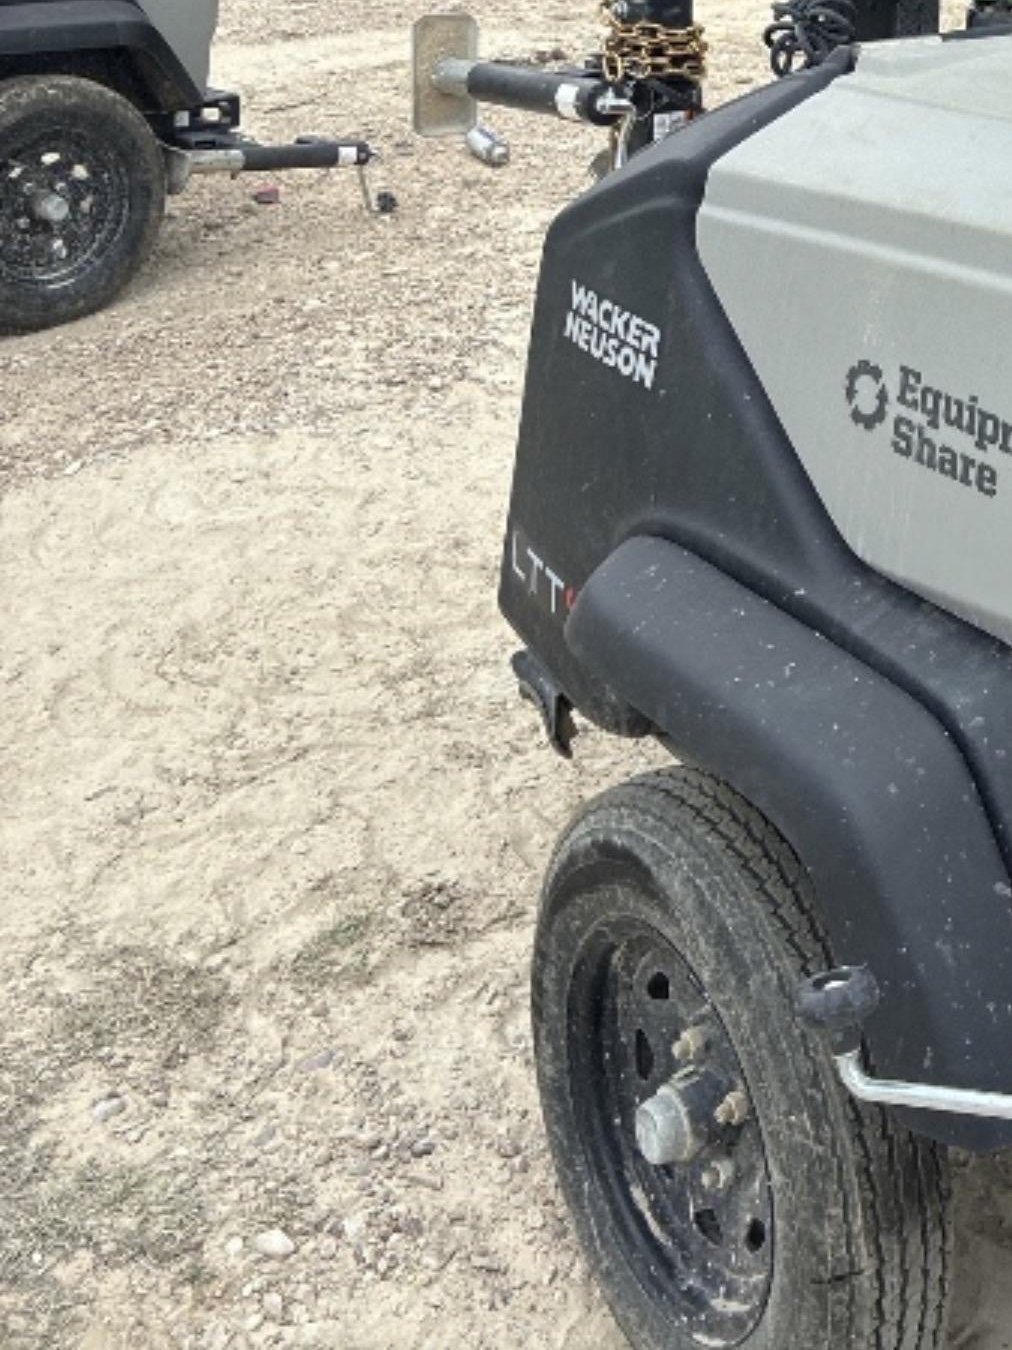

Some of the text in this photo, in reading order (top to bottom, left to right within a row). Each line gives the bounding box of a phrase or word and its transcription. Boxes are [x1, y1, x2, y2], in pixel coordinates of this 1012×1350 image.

[562, 310, 658, 390] NEUSON
[571, 278, 661, 358] WACKER
[891, 413, 998, 498] Share
